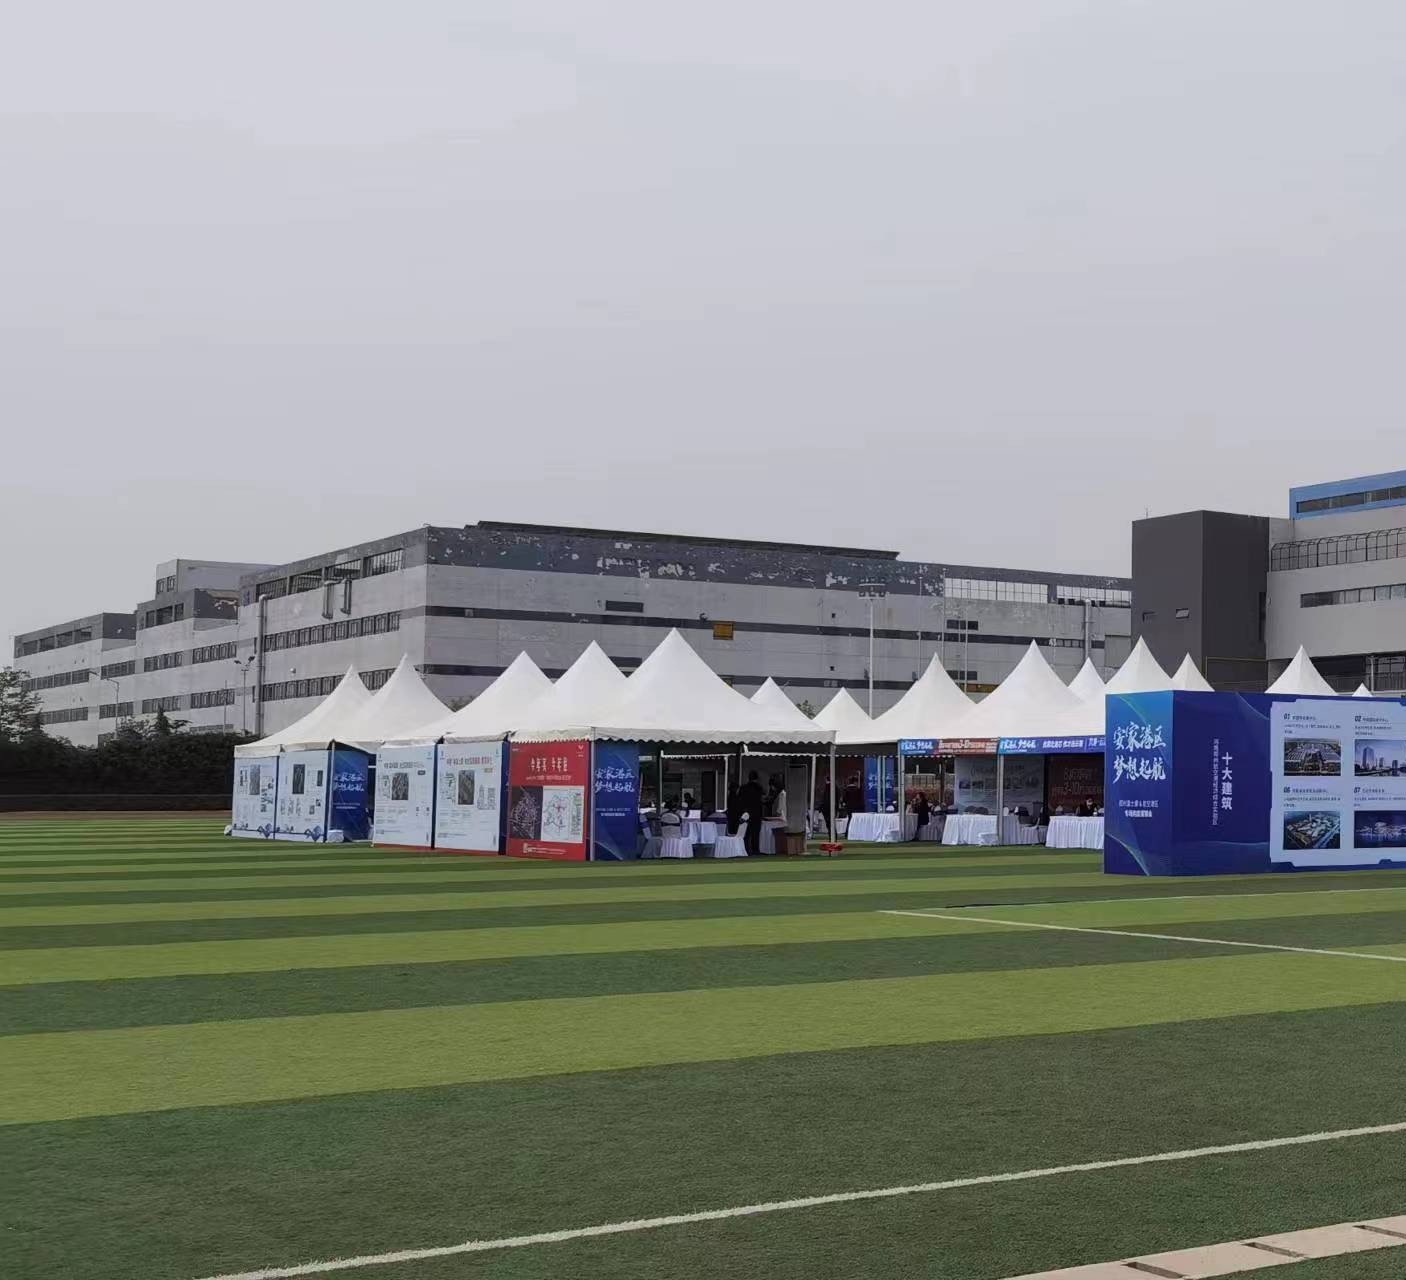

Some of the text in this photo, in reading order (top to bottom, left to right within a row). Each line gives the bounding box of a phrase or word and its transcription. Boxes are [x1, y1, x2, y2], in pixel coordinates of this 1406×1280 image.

[1113, 721, 1166, 752] 安家港区
[1112, 755, 1166, 784] 梦想起航
[1221, 751, 1232, 810] 十大建筑
